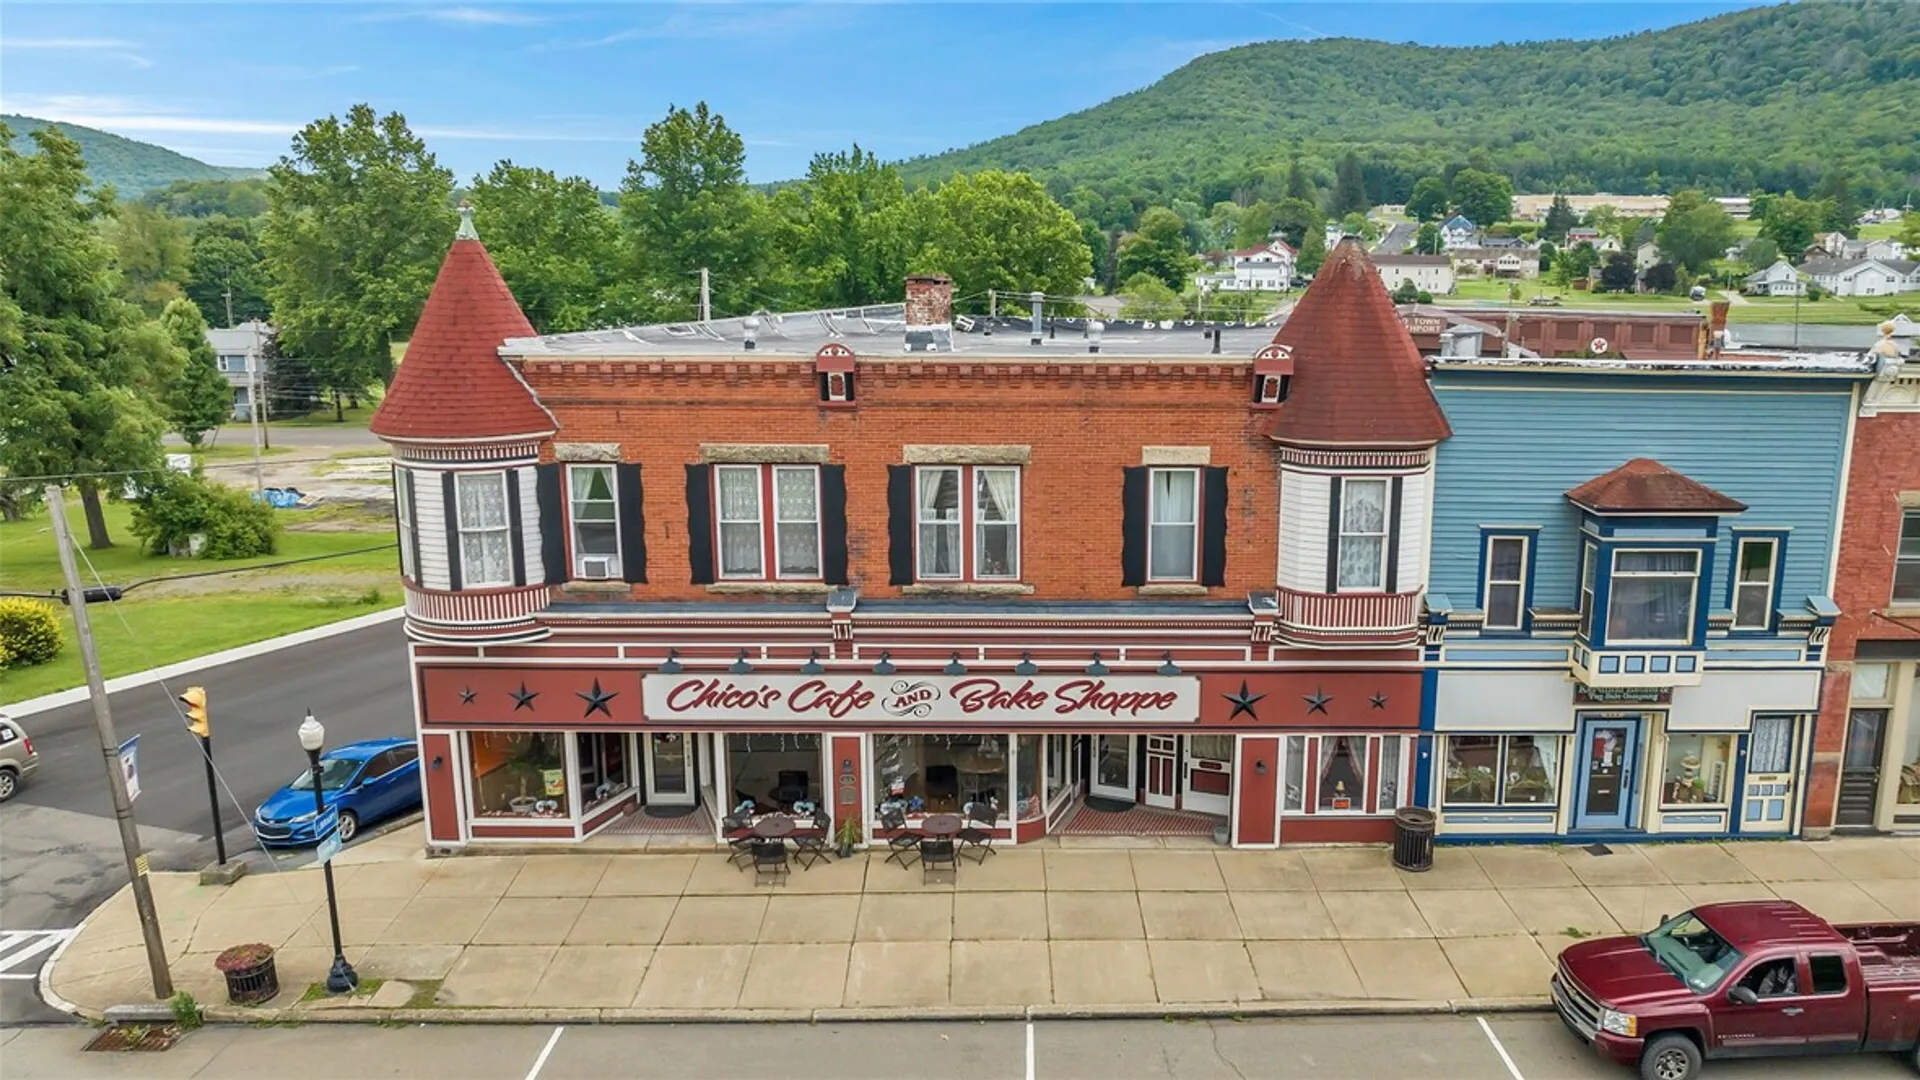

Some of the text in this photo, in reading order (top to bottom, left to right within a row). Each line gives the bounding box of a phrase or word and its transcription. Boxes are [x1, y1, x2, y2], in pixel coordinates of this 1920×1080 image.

[1414, 317, 1441, 325] TOWN
[666, 678, 1178, 718] Chico's Cafe AND Bake Shoppe
